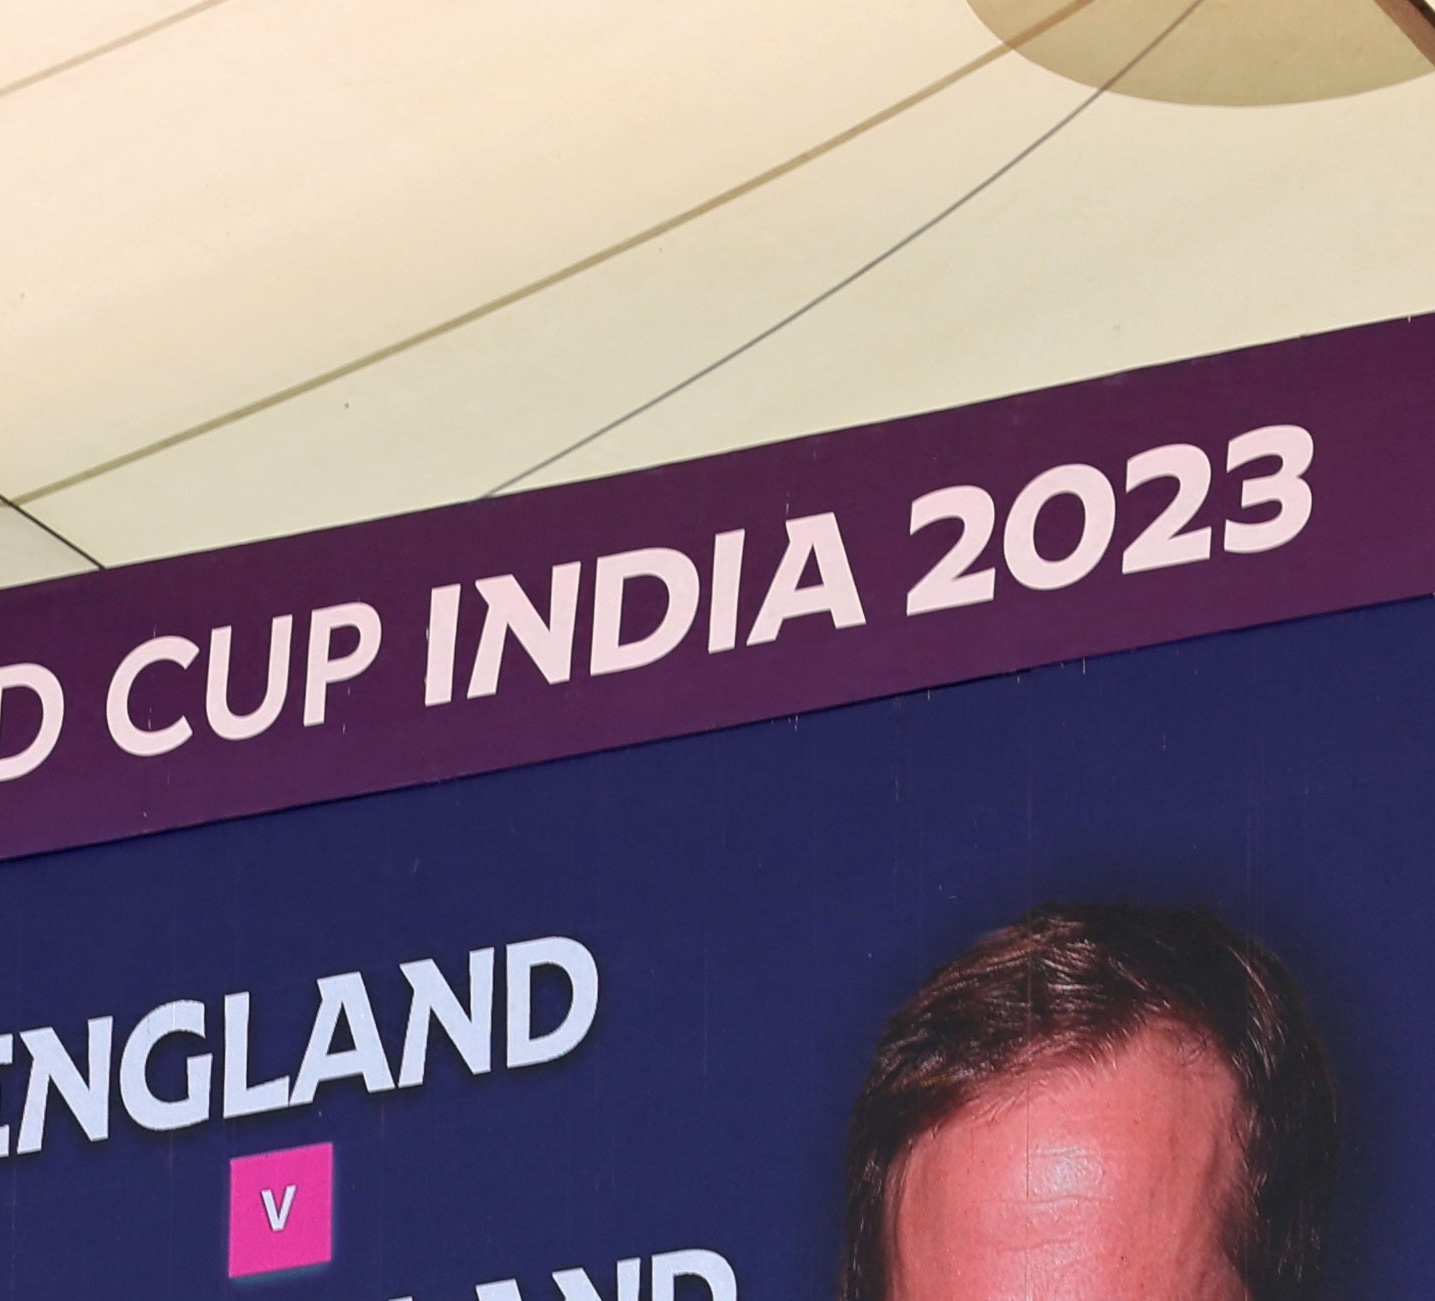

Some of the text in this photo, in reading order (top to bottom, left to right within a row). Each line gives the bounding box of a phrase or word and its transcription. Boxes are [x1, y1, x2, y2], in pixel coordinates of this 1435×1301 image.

[106, 602, 382, 756] CUP
[424, 512, 867, 707] INDIA
[906, 425, 1314, 616] 2023
